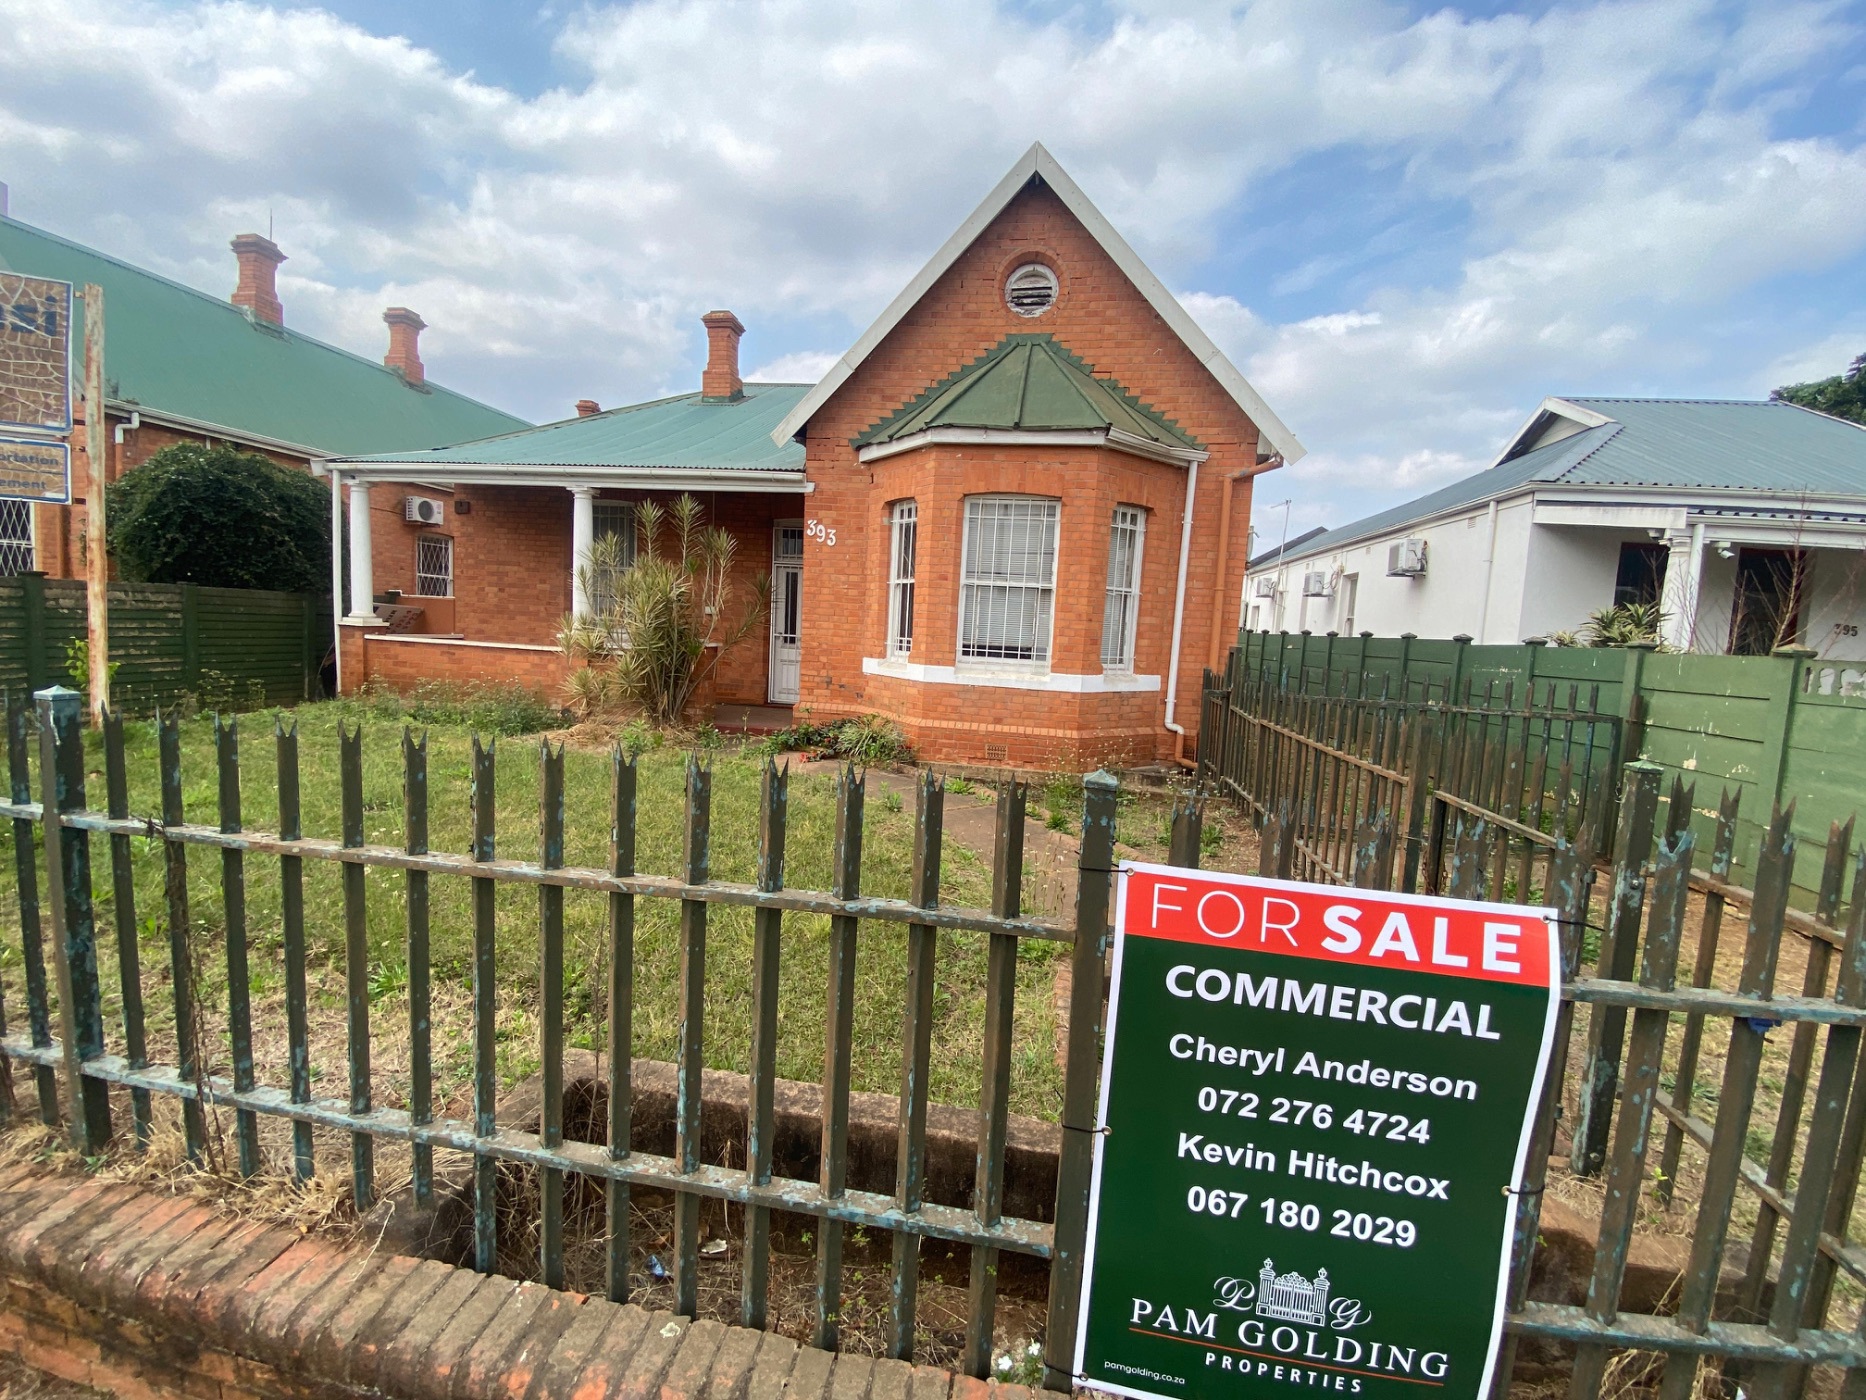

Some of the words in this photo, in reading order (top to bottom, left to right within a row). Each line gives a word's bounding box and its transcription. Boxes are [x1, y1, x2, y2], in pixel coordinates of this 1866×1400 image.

[806, 519, 837, 547] 393
[1151, 883, 1301, 947] FOR
[1320, 905, 1523, 975] SALE
[1165, 964, 1501, 1041] COMMERCIAL
[1169, 1033, 1286, 1076] Cheryl
[1292, 1051, 1478, 1101] Anderson
[1197, 1086, 1260, 1119] 072
[1268, 1097, 1334, 1130] 276
[1342, 1108, 1431, 1145] 4724
[1177, 1132, 1276, 1172] Kevin
[1287, 1149, 1450, 1200] Hitchcox
[1187, 1185, 1249, 1219] 067
[1260, 1197, 1320, 1232] 180
[1329, 1209, 1417, 1248] 2029
[1129, 1297, 1219, 1339] PAM
[1237, 1320, 1450, 1378] GOLDING
[1104, 1359, 1186, 1386] pamgolding.co.za
[1205, 1352, 1362, 1393] PROPERTIES
